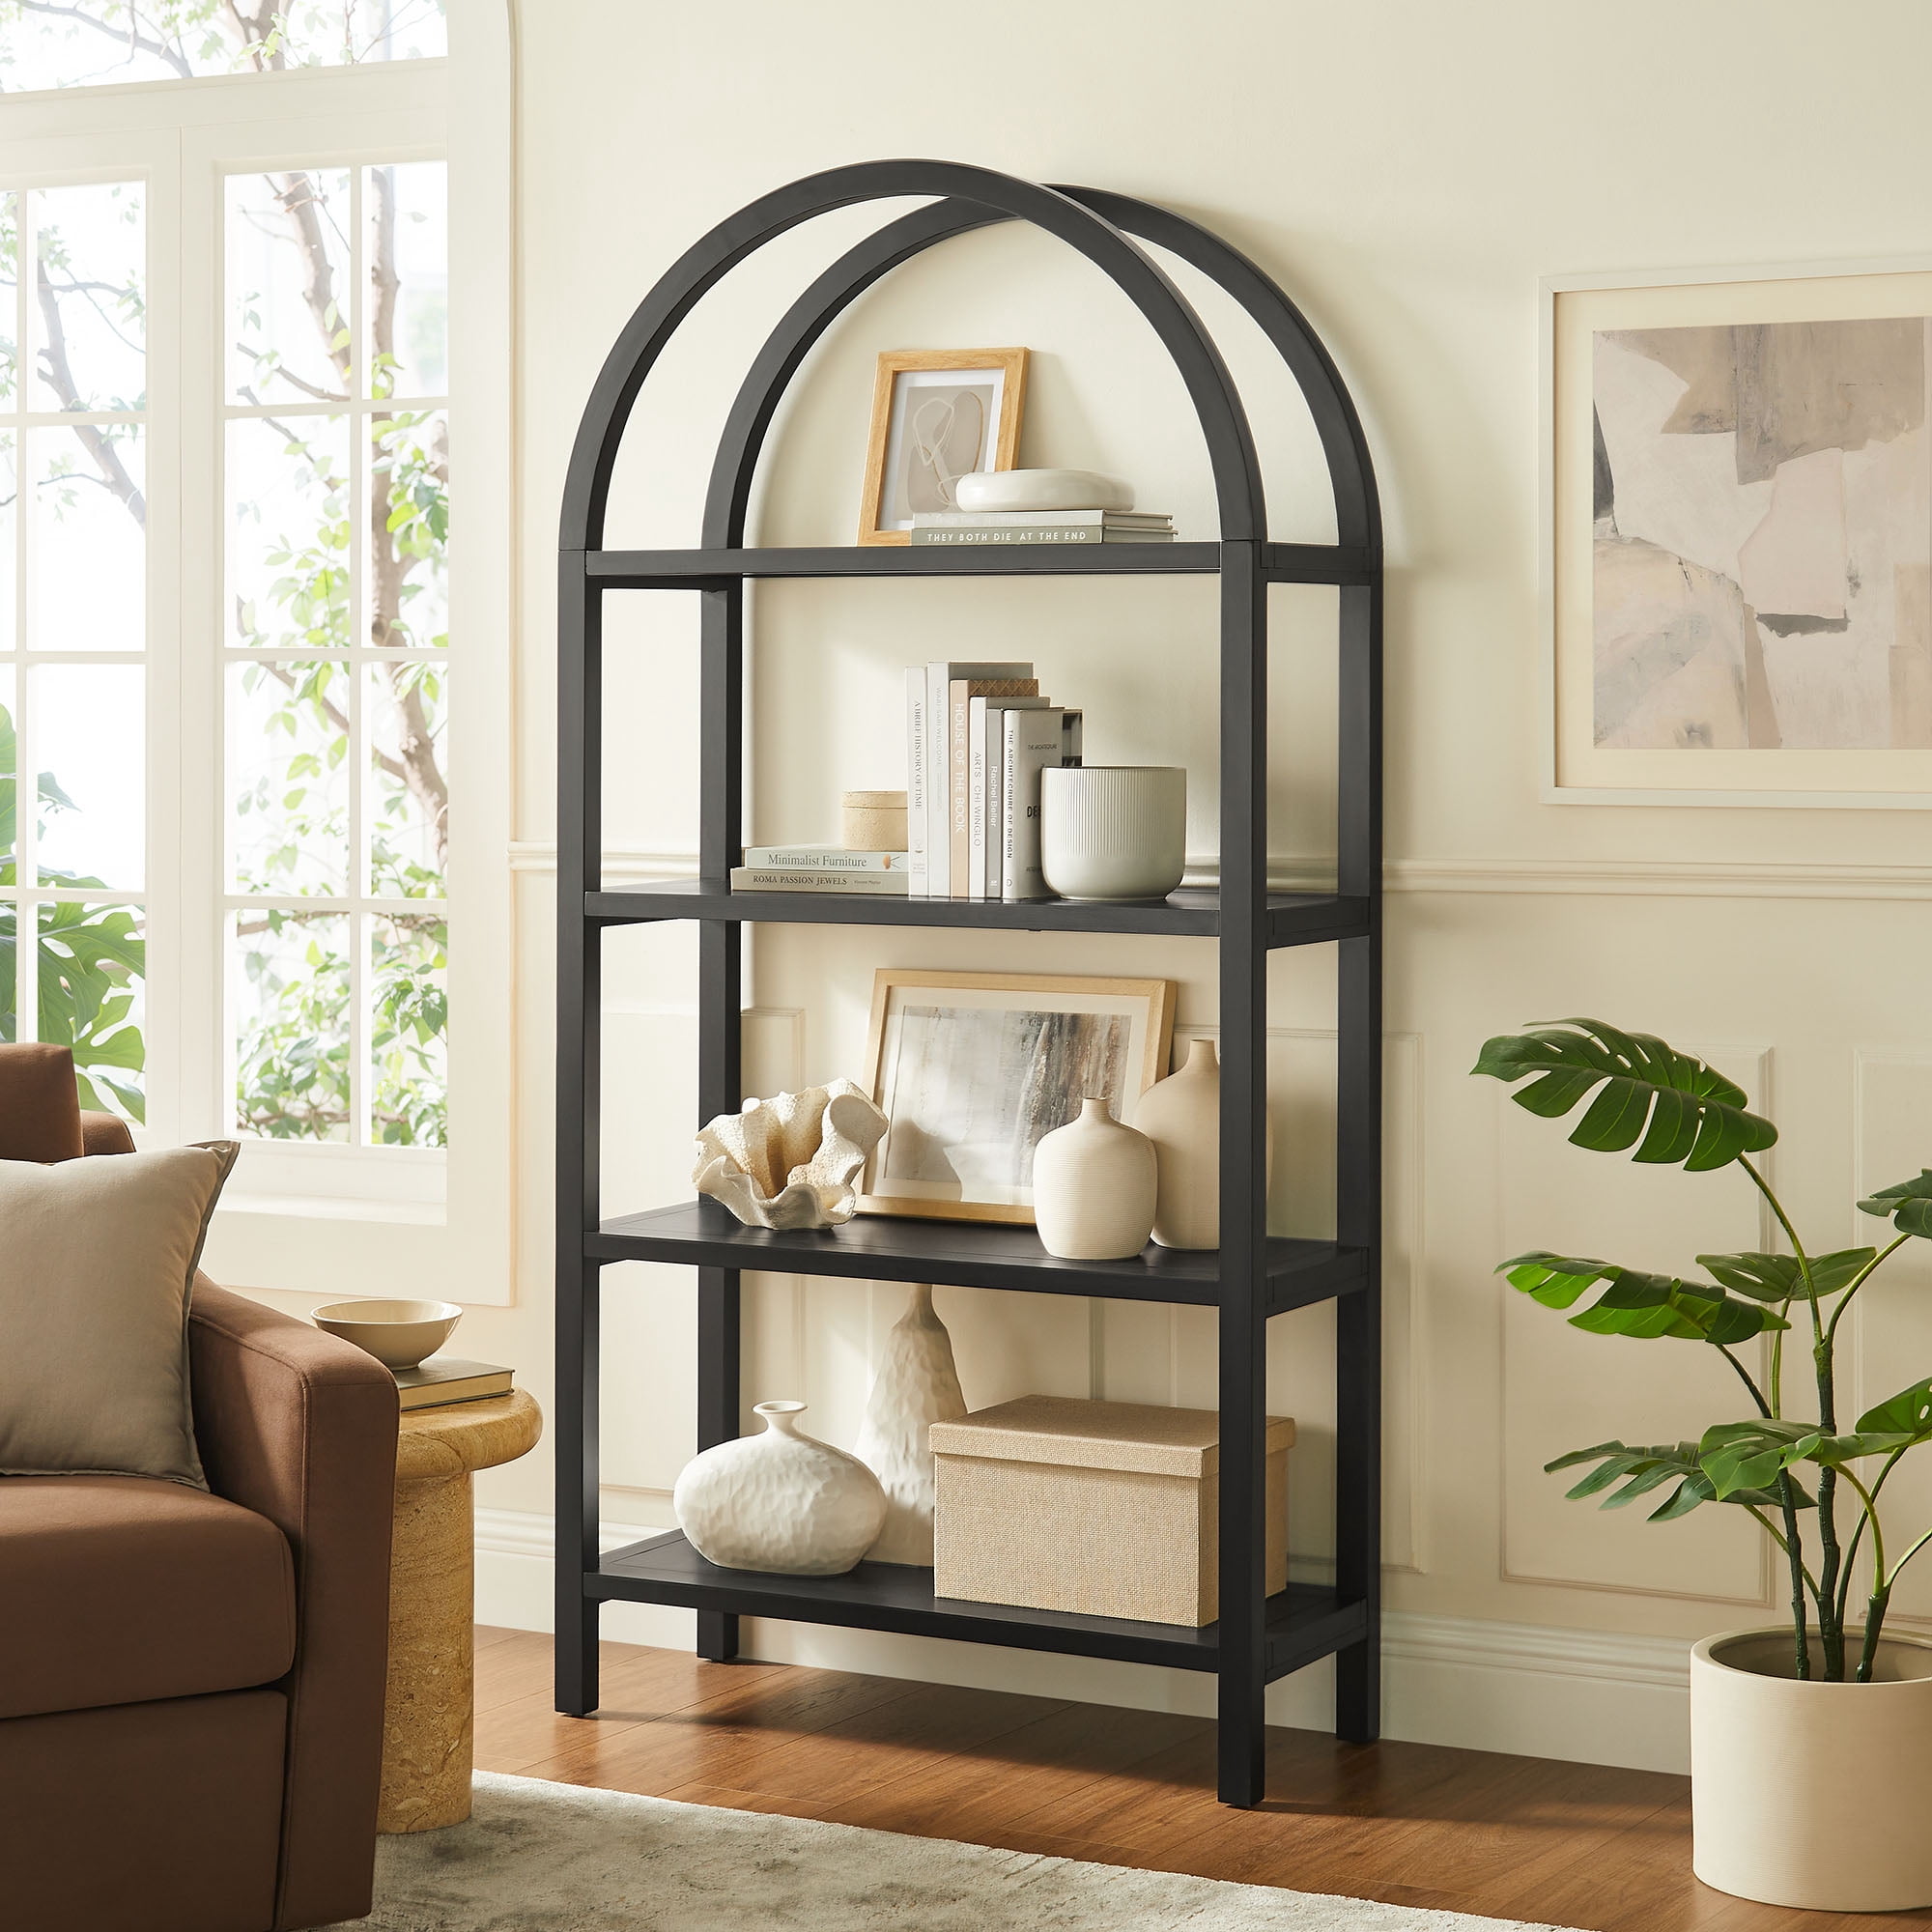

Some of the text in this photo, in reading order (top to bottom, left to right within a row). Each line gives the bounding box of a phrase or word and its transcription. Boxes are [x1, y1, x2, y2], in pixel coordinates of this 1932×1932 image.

[927, 531, 1087, 542] THEY BOTH DIE AT THE END
[954, 703, 965, 834] HOUSE OF THE BOOK
[914, 774, 922, 786] OF
[1007, 814, 1013, 825] OF
[768, 854, 867, 867] Minimalist Furniture
[816, 877, 848, 886] JEWELS
